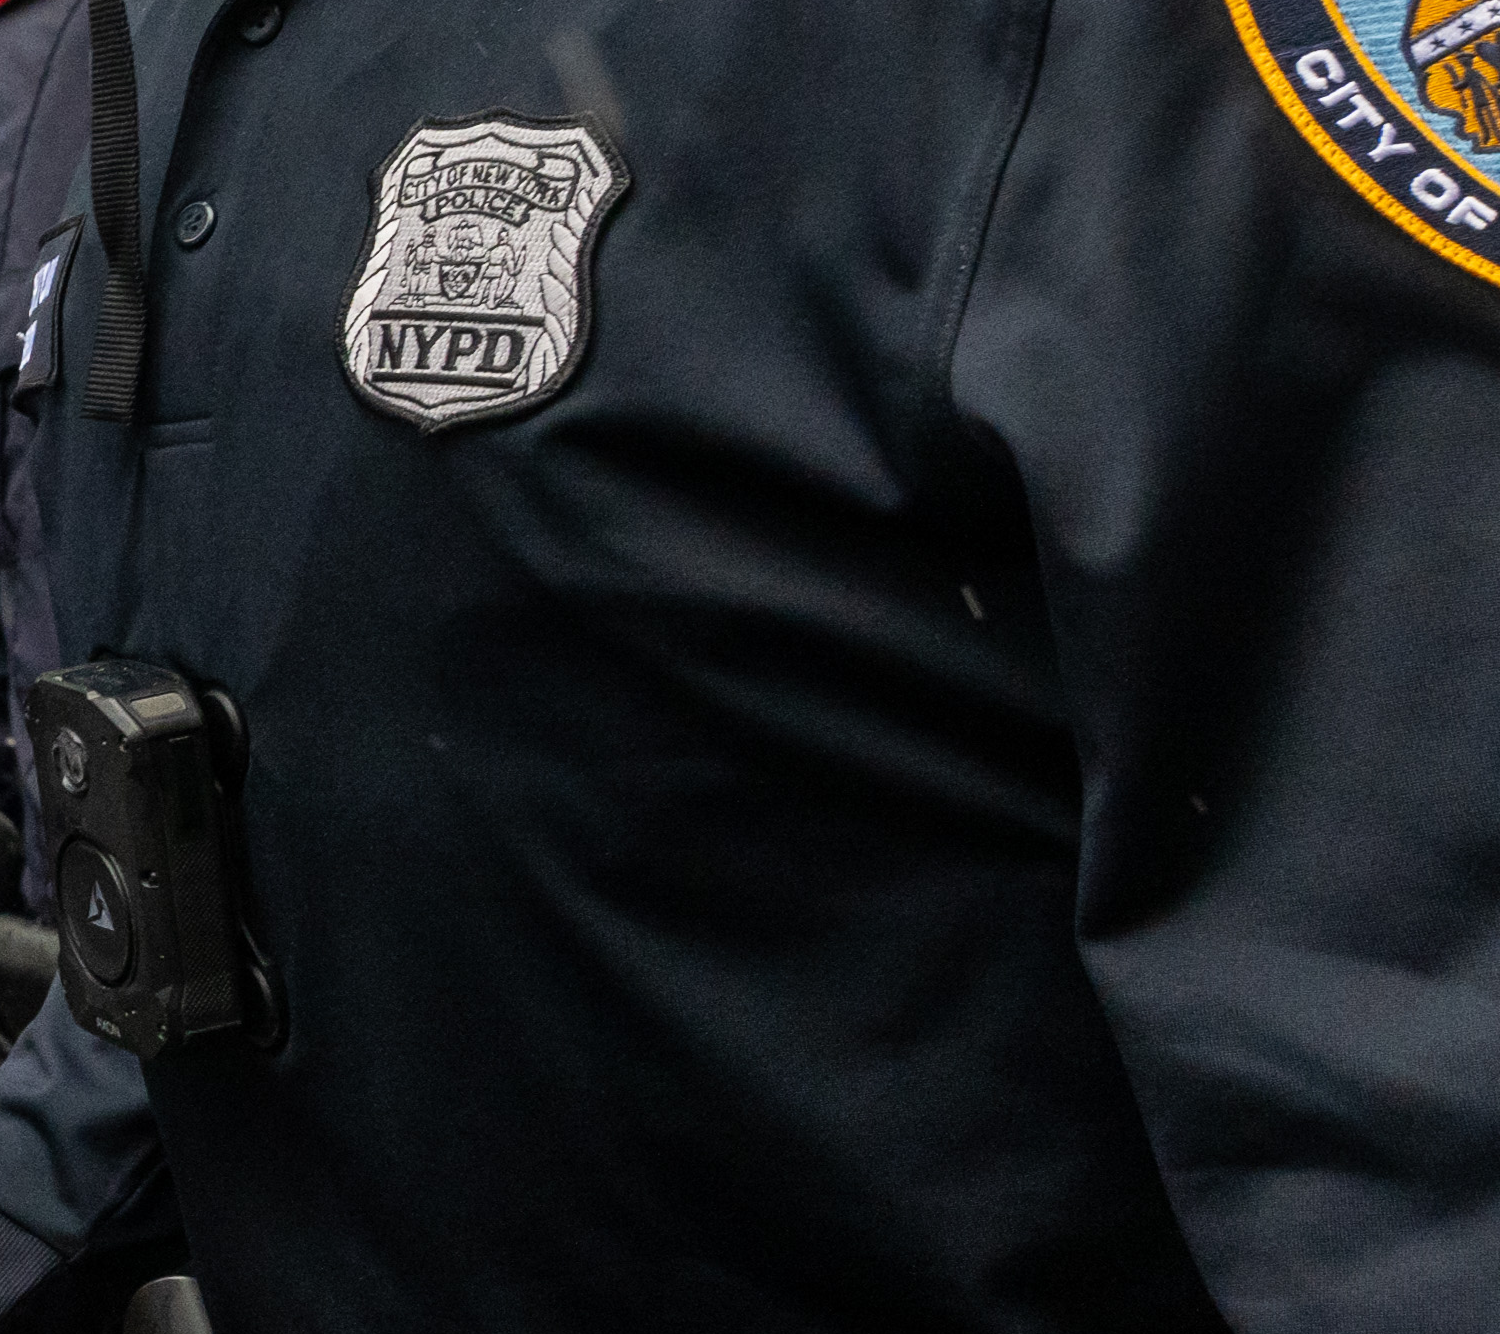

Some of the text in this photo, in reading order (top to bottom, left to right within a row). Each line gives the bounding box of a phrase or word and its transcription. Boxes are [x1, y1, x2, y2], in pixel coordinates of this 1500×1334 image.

[1295, 50, 1497, 230] CITY OF
[403, 163, 566, 206] CITY OF NEW YORK
[436, 191, 520, 218] POLICE
[376, 324, 526, 374] NYPD
